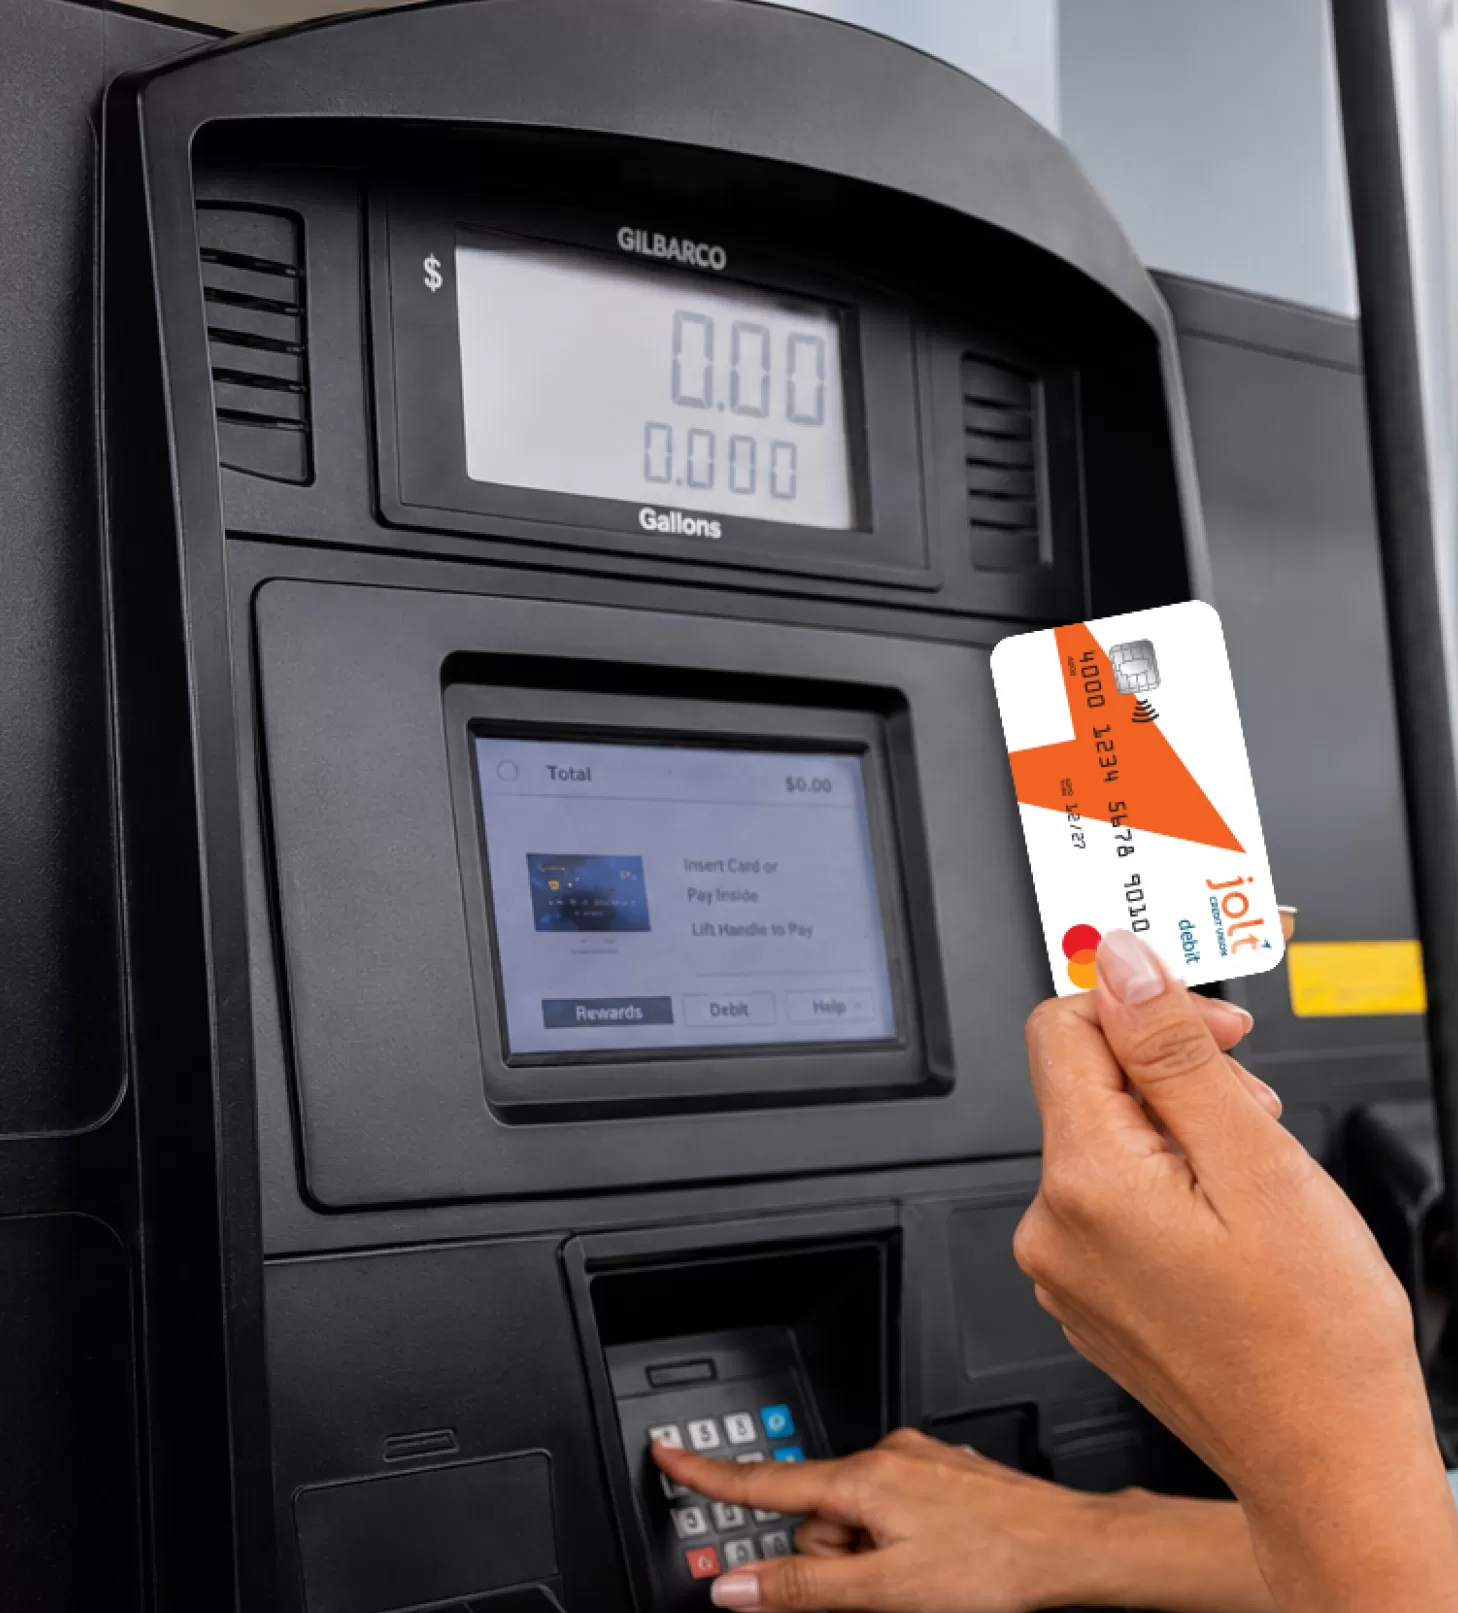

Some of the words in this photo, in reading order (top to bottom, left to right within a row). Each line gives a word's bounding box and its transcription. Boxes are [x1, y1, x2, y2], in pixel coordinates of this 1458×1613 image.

[617, 226, 727, 270] GILBARCO
[423, 253, 443, 292] $
[671, 310, 826, 426] 0.00
[644, 421, 797, 500] 0.000
[638, 507, 722, 540] Gallons
[547, 764, 592, 782] Total
[785, 776, 832, 794] $0.00
[1079, 650, 1106, 709] 4000
[1093, 724, 1120, 783] 1234
[1108, 801, 1135, 858] 5678
[1124, 873, 1151, 933] 9010
[1065, 803, 1087, 850] 12/27
[684, 858, 725, 873] Insert
[727, 857, 760, 874] Card
[762, 861, 778, 873] or
[687, 887, 712, 905] Pay
[715, 887, 760, 903] Inside
[1209, 895, 1222, 926] CREDIT
[692, 921, 717, 937] Lift
[718, 922, 768, 937] Handle
[770, 922, 785, 937] to
[788, 921, 814, 939] Pay
[1206, 875, 1265, 955] jolt
[1178, 918, 1201, 965] debit
[1215, 926, 1228, 957] UNION
[575, 1004, 643, 1021] Rewards
[710, 1001, 749, 1017] Debit
[812, 999, 847, 1015] Help
